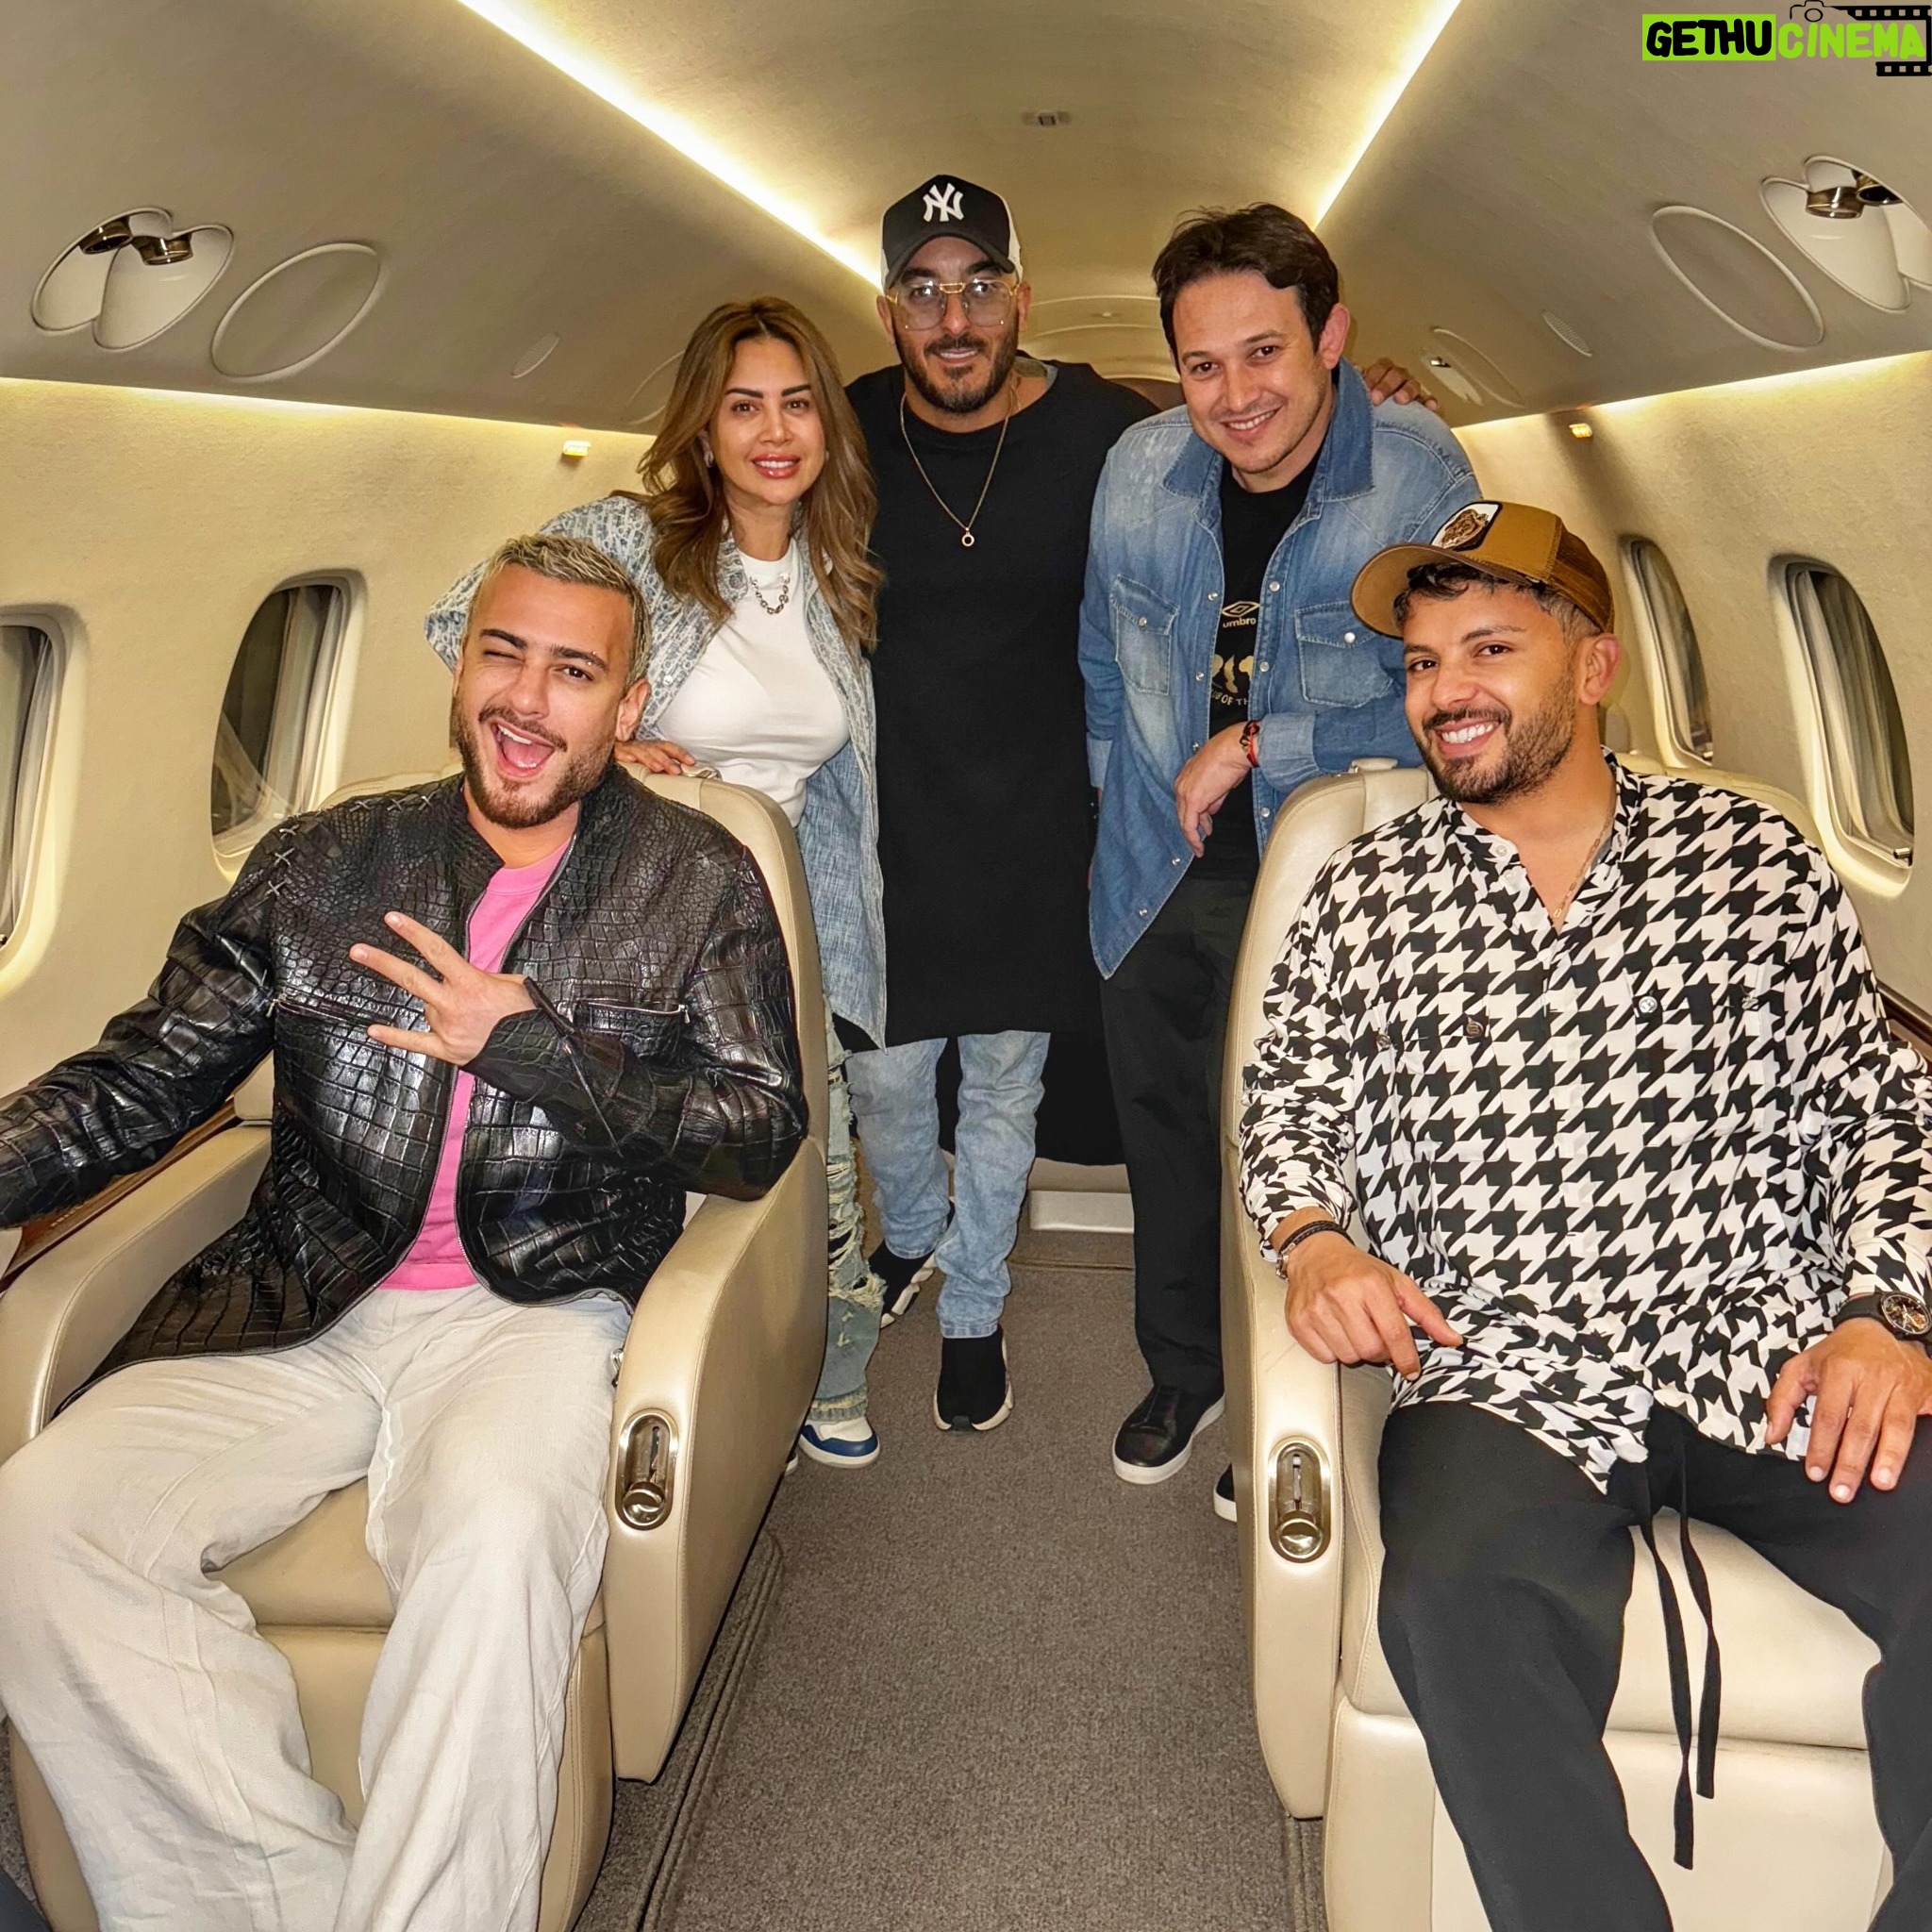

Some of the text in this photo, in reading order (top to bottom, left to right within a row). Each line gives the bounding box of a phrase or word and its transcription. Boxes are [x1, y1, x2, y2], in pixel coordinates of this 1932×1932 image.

[923, 182, 964, 223] NY
[1223, 618, 1257, 628] umbro
[1221, 694, 1234, 706] OF
